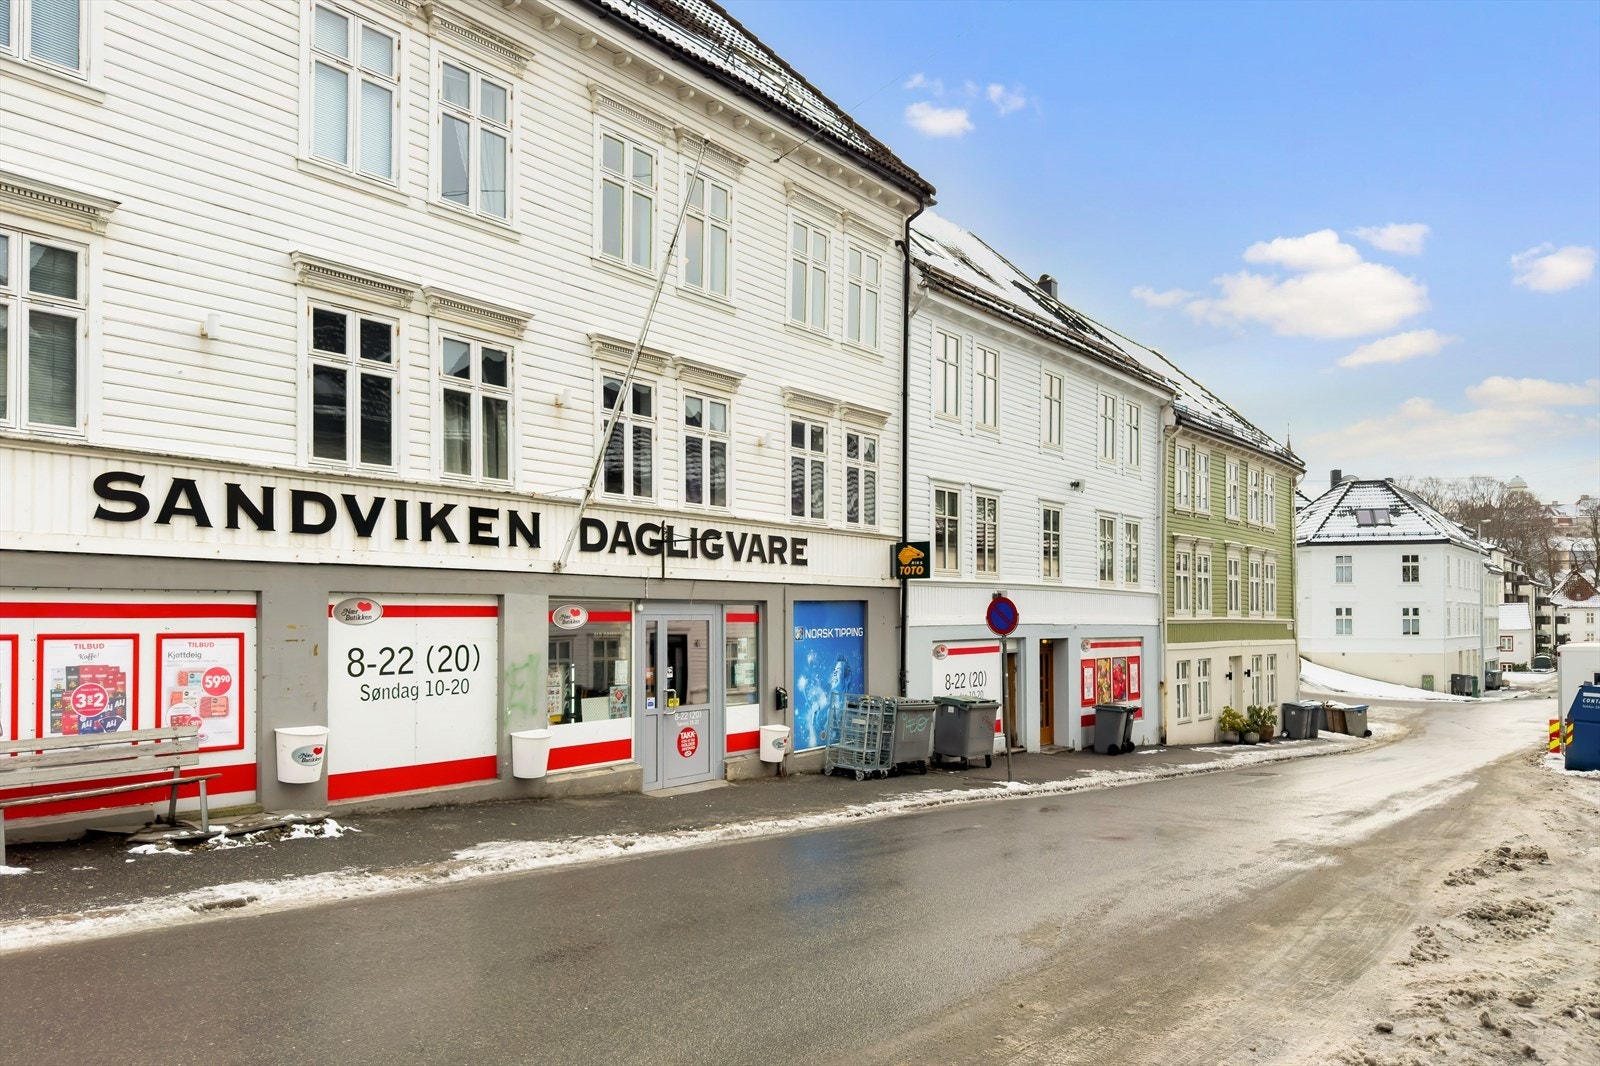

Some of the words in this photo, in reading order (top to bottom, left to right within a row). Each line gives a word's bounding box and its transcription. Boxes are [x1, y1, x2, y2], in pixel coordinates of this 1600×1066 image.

[92, 470, 541, 549] SANDVIKEN
[579, 516, 808, 566] DAGLIGVARE
[899, 565, 924, 575] TOTO
[341, 608, 358, 616] Nær
[345, 613, 372, 621] Butikken
[805, 628, 834, 639] NORSK
[834, 627, 864, 638] TIPPING
[346, 646, 414, 677] 8-22
[426, 644, 480, 674] (20)
[945, 672, 966, 690] 8-22
[969, 670, 987, 688] (20)
[360, 682, 419, 702] Søndag
[425, 678, 470, 697] 10-20
[75, 693, 86, 708] 3
[93, 692, 104, 707] 2
[114, 698, 125, 708] ALI
[674, 712, 688, 721] 8-22
[689, 710, 702, 719] (20)
[81, 719, 93, 729] ALI
[106, 720, 117, 728] ALI
